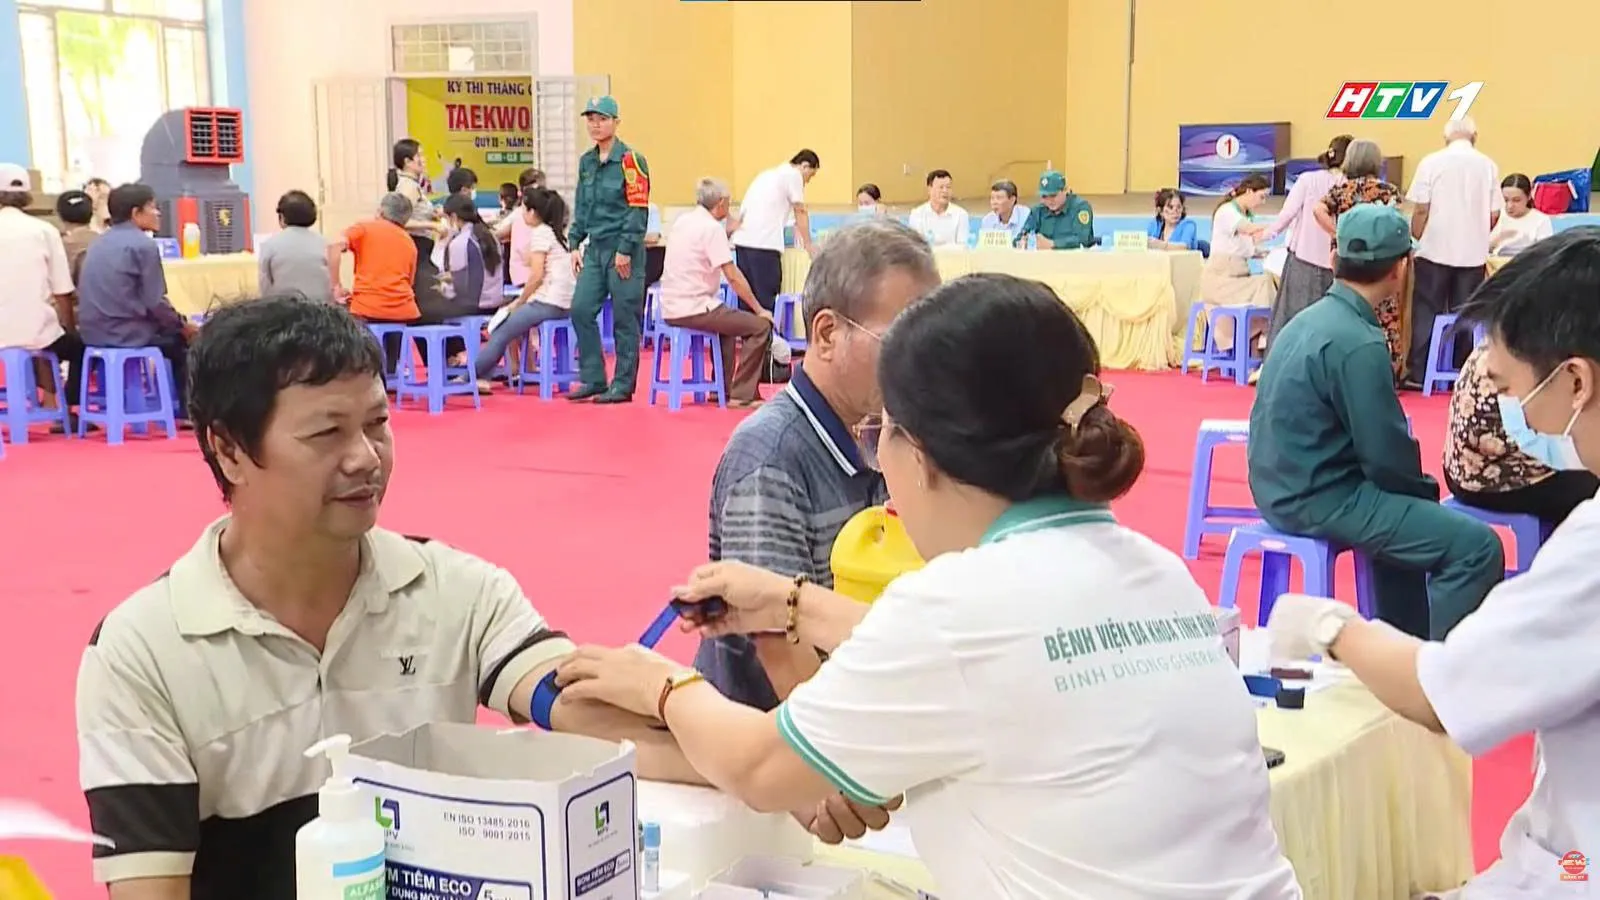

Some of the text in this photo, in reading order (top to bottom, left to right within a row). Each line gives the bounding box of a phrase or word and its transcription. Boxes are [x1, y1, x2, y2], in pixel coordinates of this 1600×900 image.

[466, 81, 484, 94] THI
[445, 104, 533, 132] TAEKWO
[1224, 137, 1232, 156] 1
[1043, 627, 1097, 664] BỆNH
[1095, 618, 1132, 654] VIỆN
[1144, 618, 1179, 644] KHOA
[443, 811, 455, 823] EN
[458, 812, 475, 825] ISO
[459, 825, 475, 838] ISO
[401, 868, 436, 892] TIÊM
[439, 877, 472, 897] ECO
